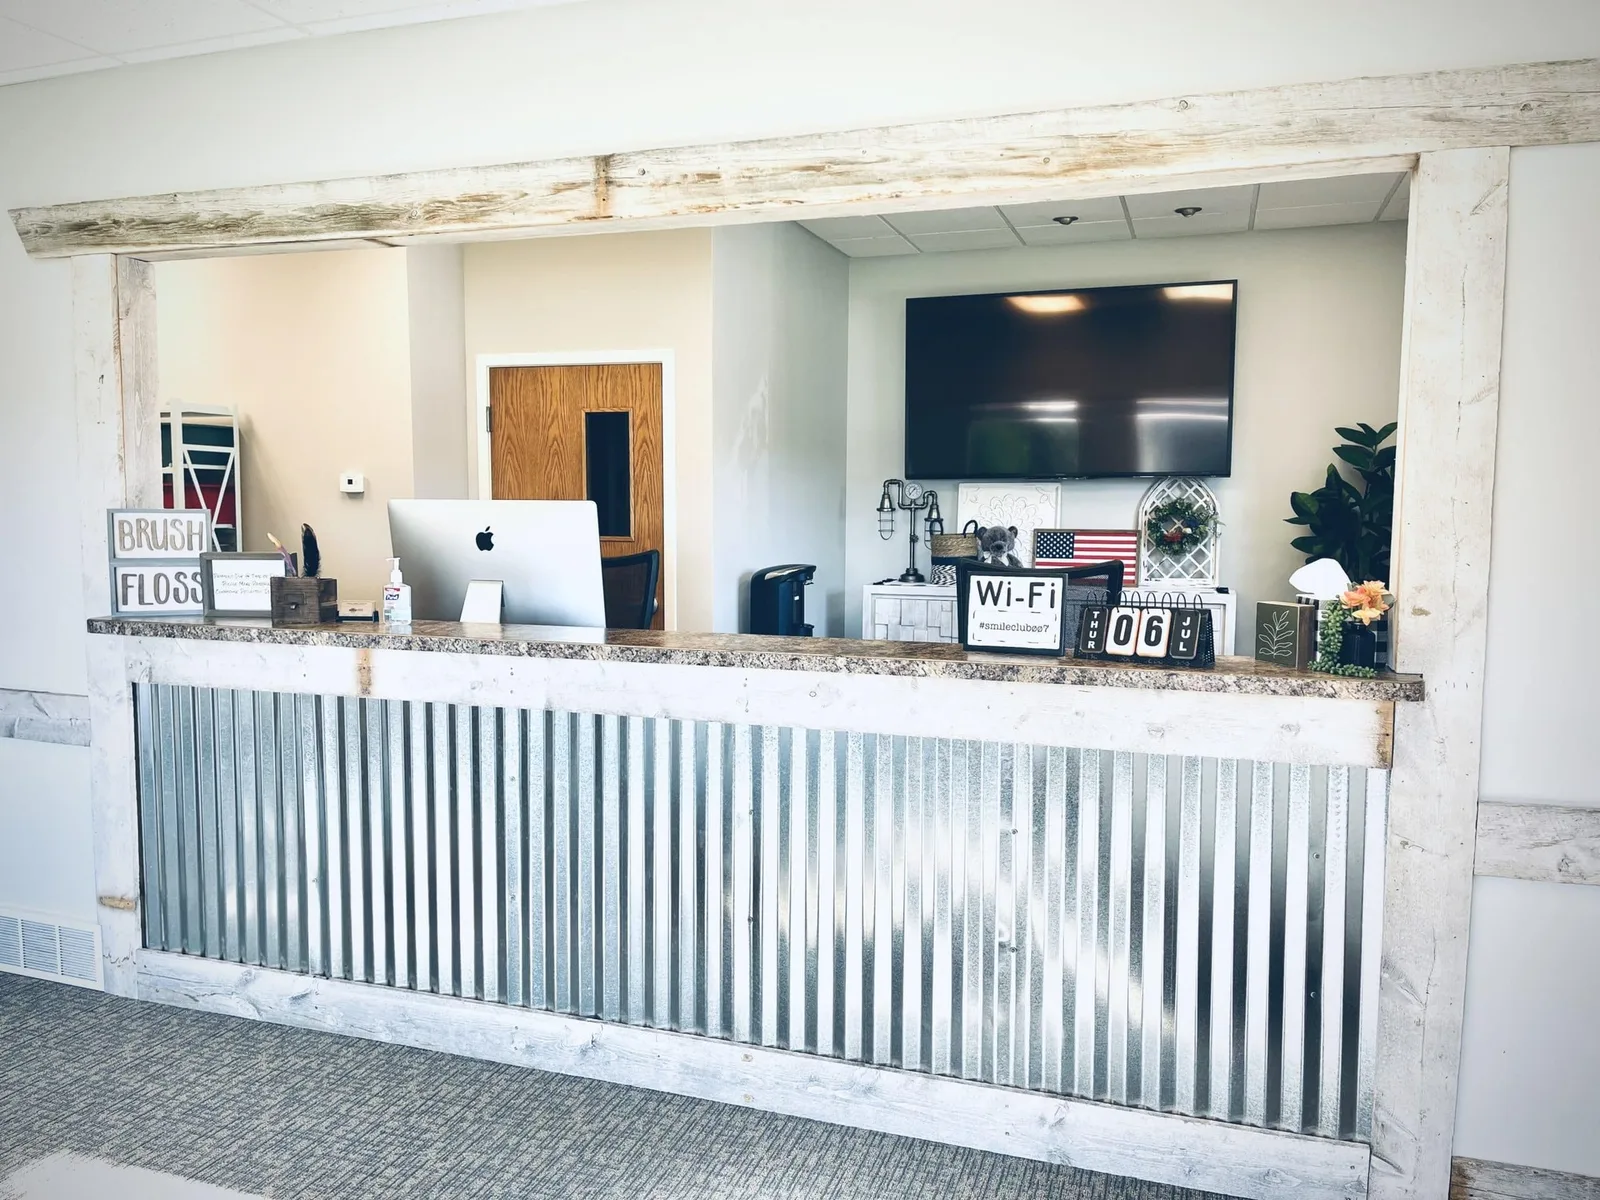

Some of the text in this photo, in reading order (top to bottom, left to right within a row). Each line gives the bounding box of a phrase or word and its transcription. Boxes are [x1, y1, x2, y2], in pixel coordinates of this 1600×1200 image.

[118, 518, 204, 551] BRUSH
[121, 571, 204, 606] FLOSS
[976, 580, 1056, 609] Wi-Fi
[1087, 611, 1191, 652] THUR 06 JUL
